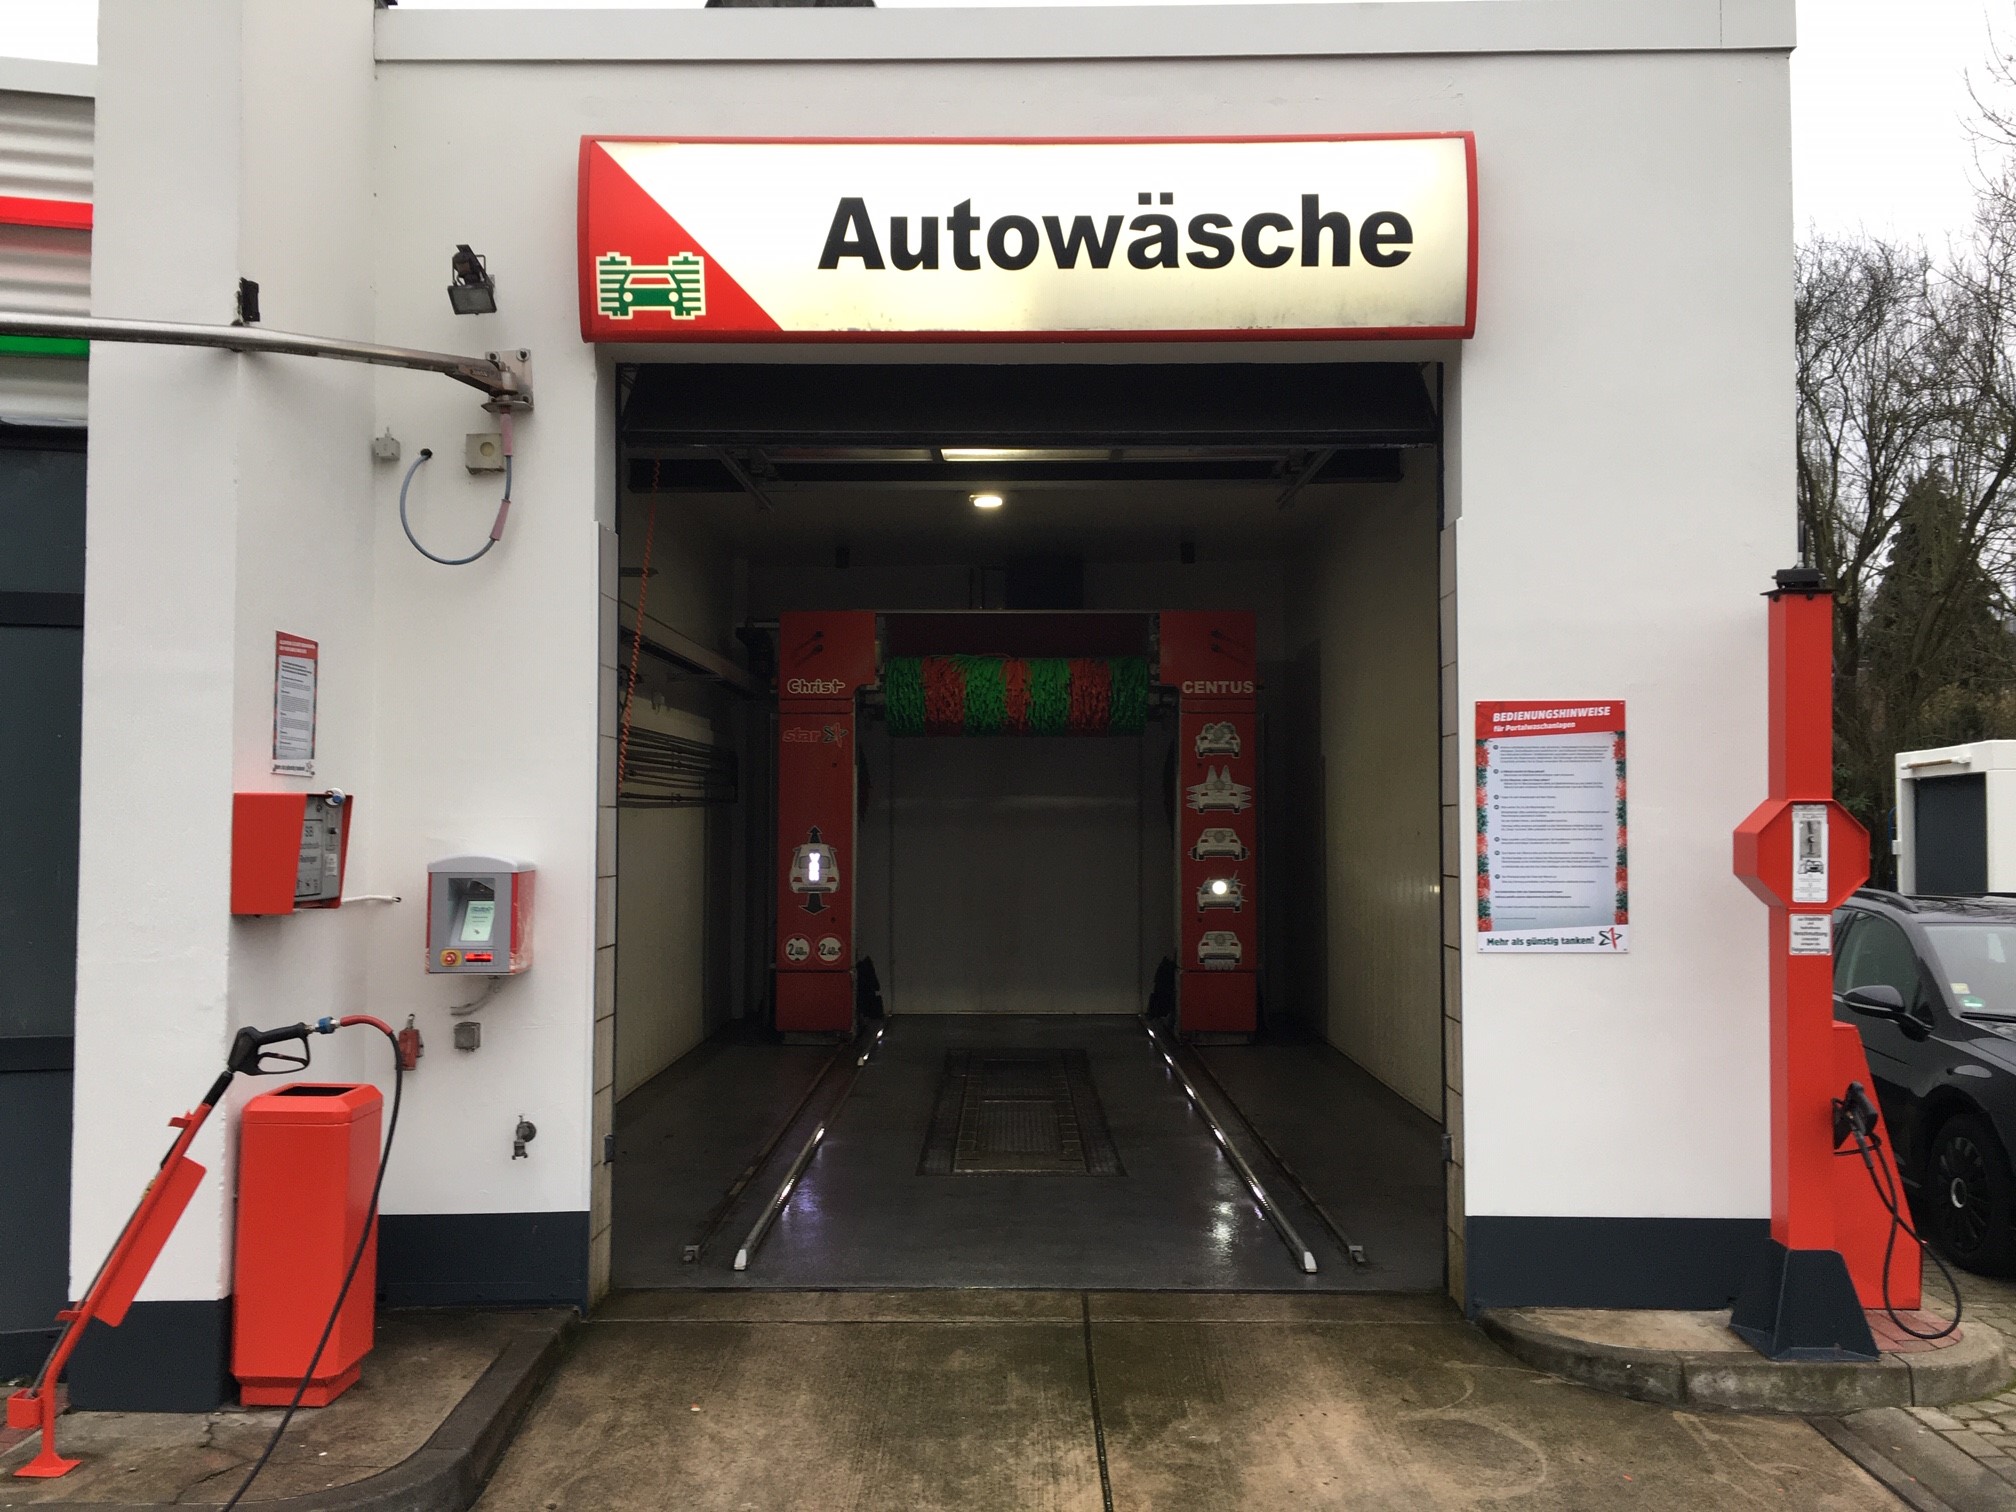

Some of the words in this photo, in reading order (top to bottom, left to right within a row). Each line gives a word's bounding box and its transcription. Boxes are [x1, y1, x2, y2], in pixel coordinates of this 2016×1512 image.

[818, 191, 1414, 270] Autowäsche
[787, 678, 846, 694] Christ
[1182, 680, 1254, 694] CENTUS
[1493, 706, 1611, 722] BEDIENUNGSHINWEISE
[783, 726, 822, 743] star
[1486, 938, 1509, 946] Mehr
[1511, 938, 1524, 946] als
[1526, 937, 1559, 947] günstig
[1561, 935, 1595, 945] tanken!
